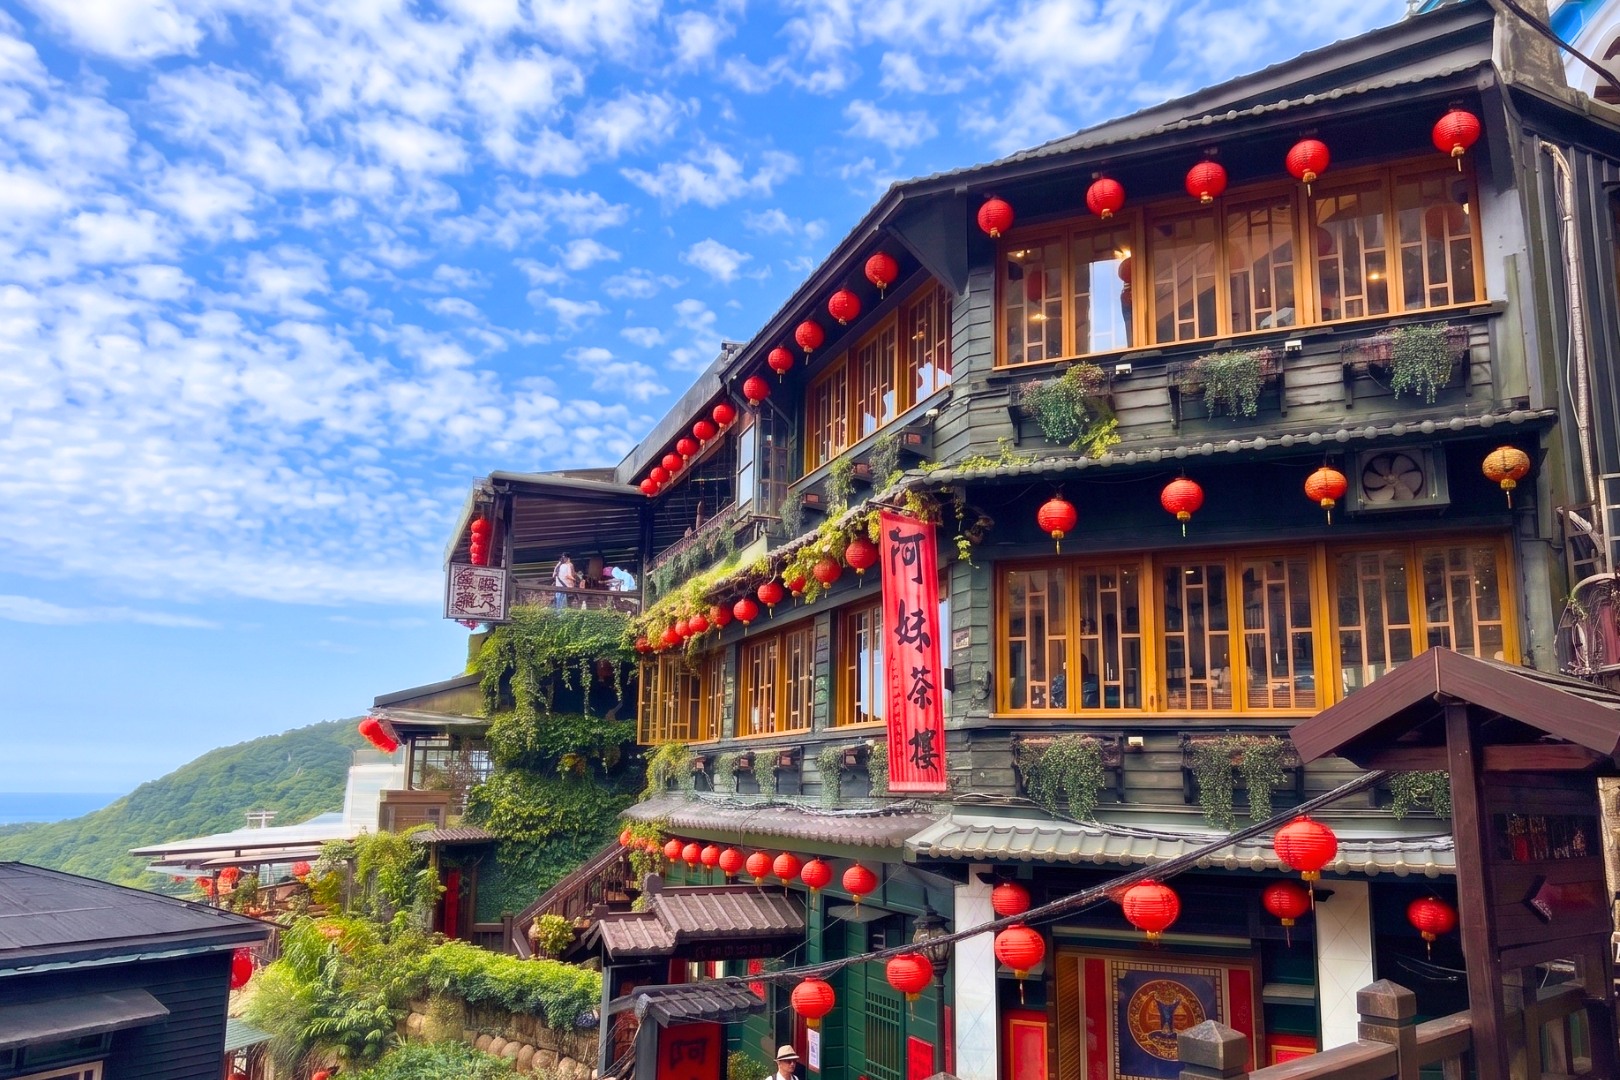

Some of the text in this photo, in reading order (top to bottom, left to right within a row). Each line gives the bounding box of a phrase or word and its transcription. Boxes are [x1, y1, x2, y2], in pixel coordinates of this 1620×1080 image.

[890, 526, 938, 771] 阿妹茶樓
[671, 1037, 711, 1080] 阿
